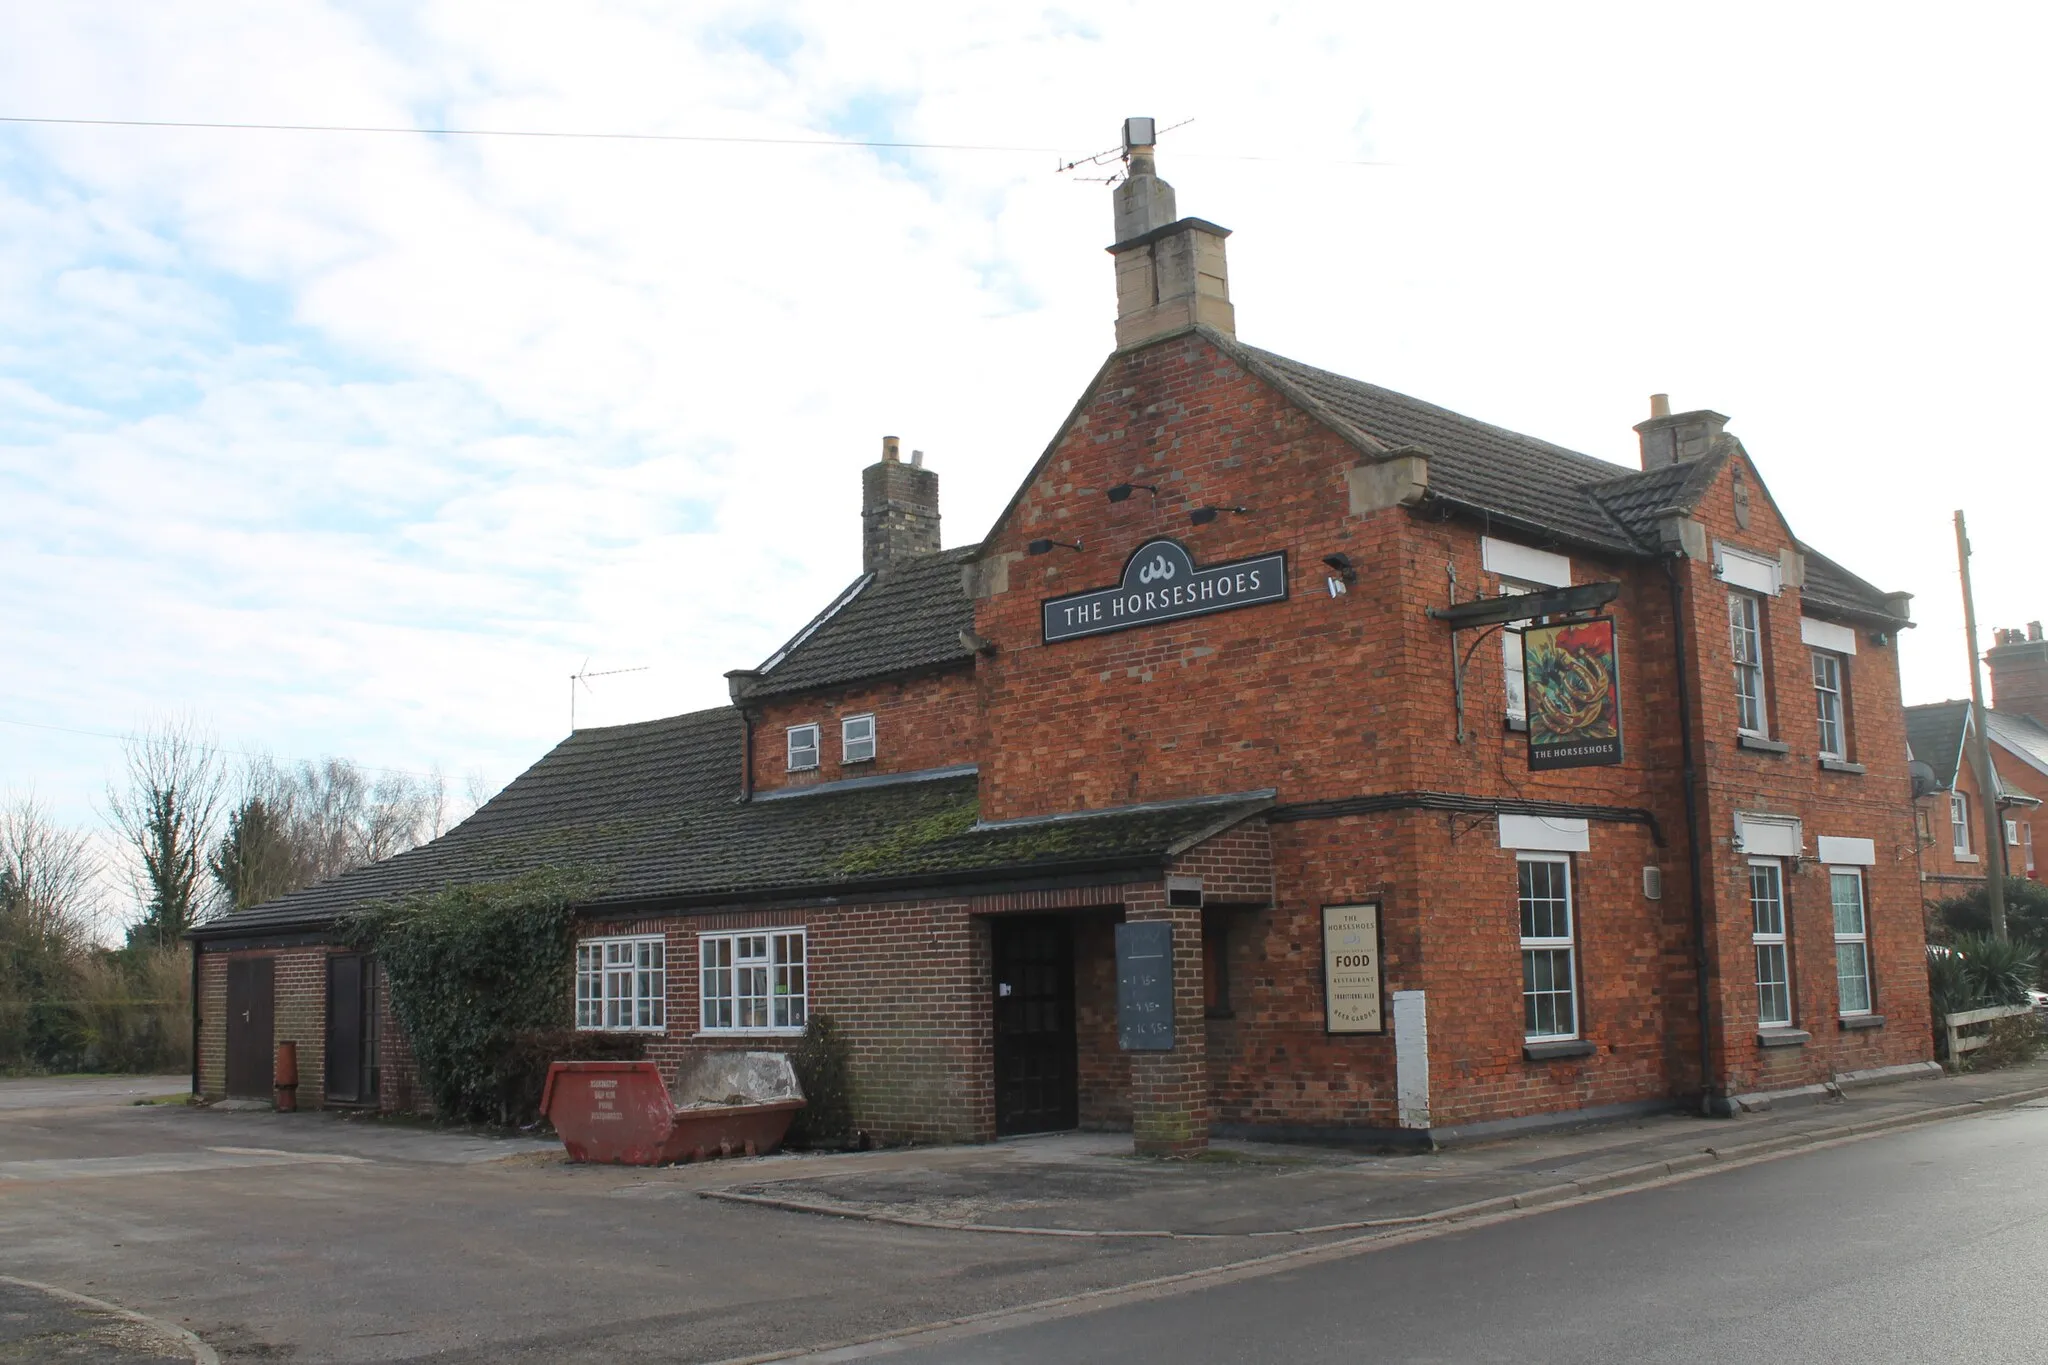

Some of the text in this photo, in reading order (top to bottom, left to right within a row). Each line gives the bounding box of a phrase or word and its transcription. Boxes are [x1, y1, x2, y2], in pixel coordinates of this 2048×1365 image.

[1064, 570, 1261, 626] THE HORSESHOES
[1535, 744, 1613, 759] THE HORSESHOES
[1328, 922, 1374, 930] HORSESHOES
[1336, 954, 1370, 967] FOOD
[1334, 1008, 1376, 1022] BEER GARDEN
